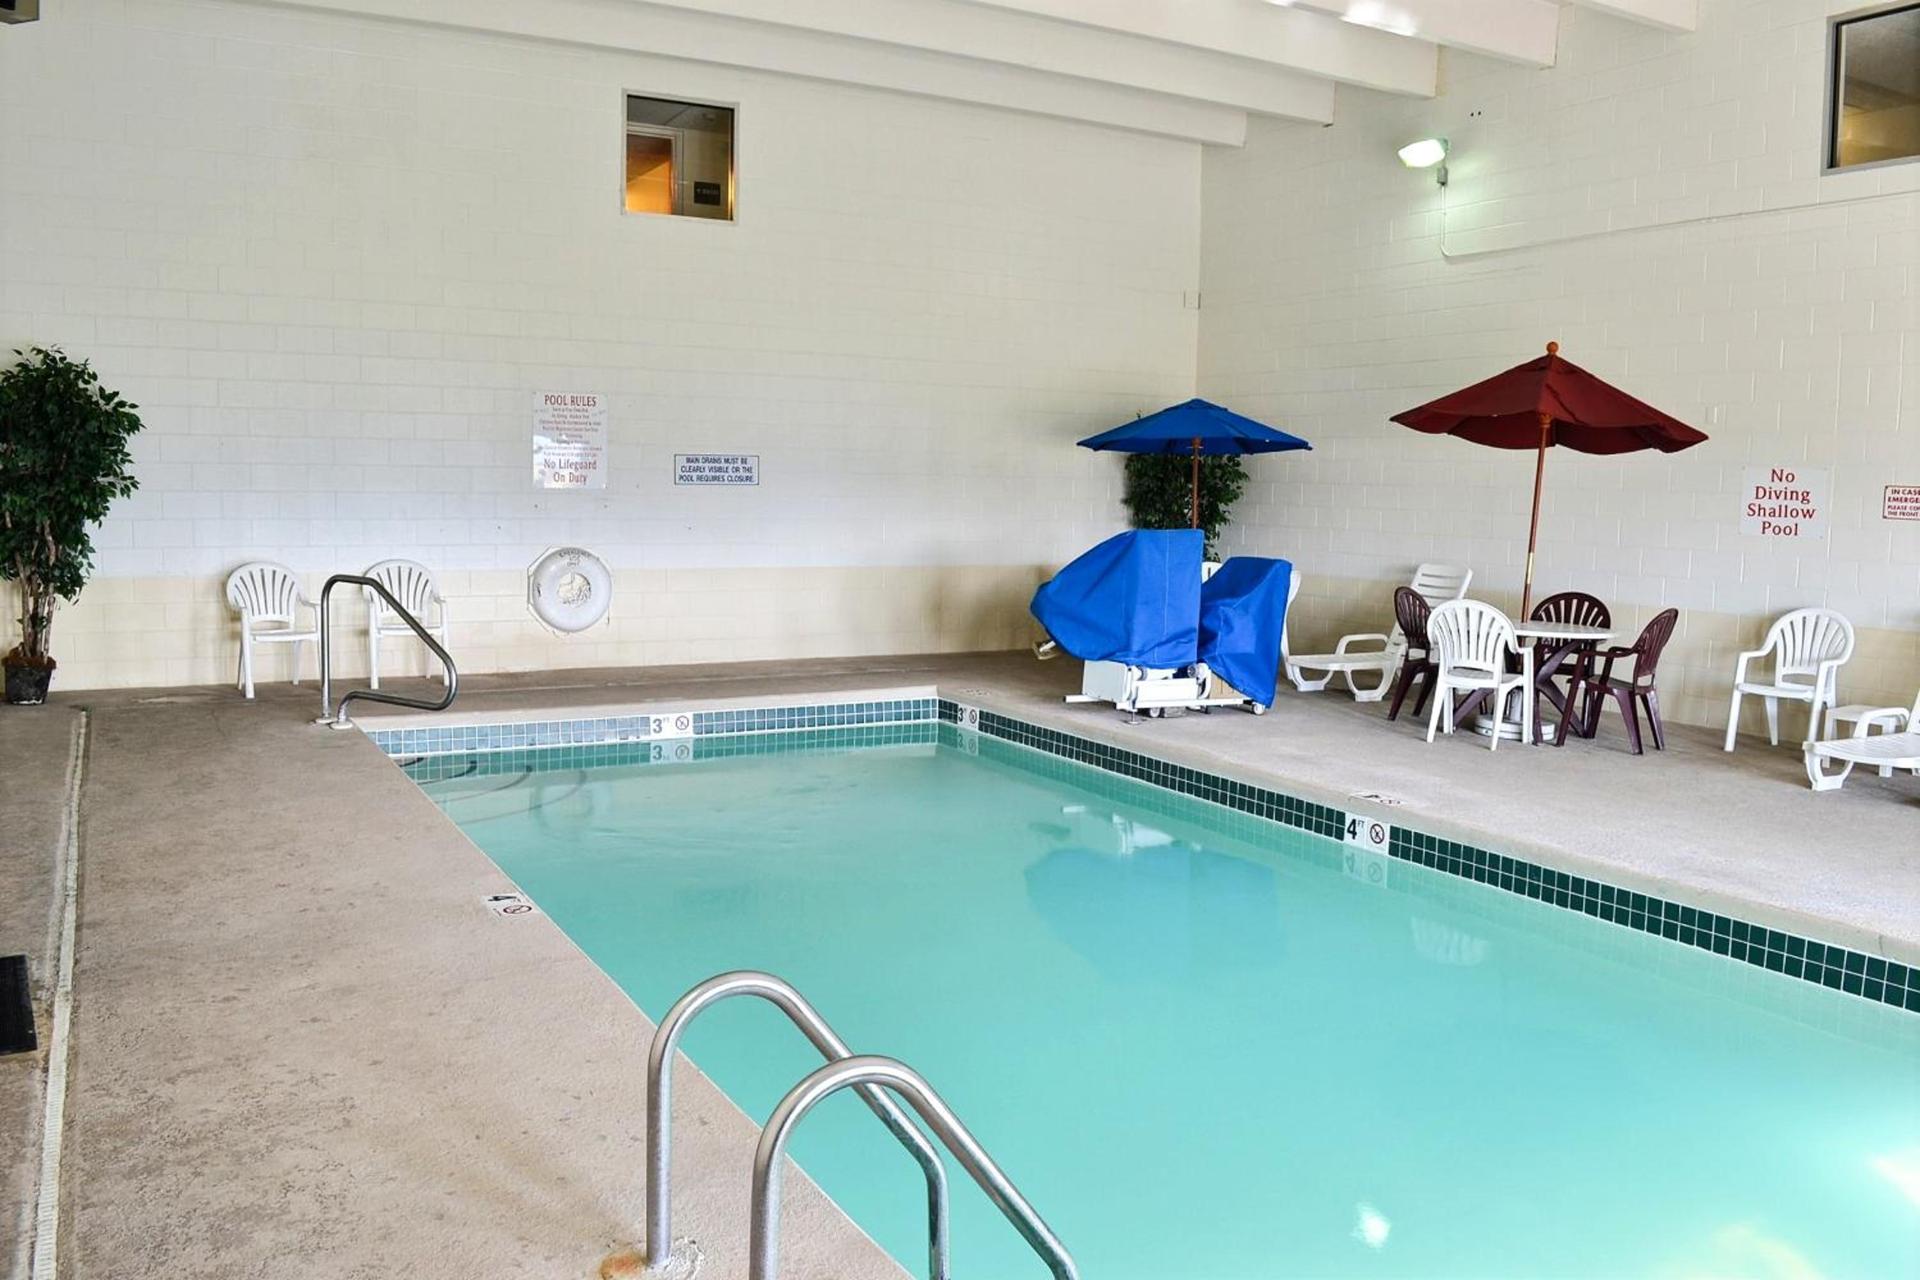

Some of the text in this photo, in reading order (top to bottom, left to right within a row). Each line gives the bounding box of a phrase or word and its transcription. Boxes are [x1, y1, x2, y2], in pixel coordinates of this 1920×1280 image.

[544, 394, 597, 407] POOL RULES
[544, 458, 597, 471] No Lifeguard
[723, 457, 739, 465] MUST
[680, 465, 706, 473] CLEARLY
[1771, 468, 1796, 483] No
[553, 472, 588, 485] On Duty
[679, 474, 694, 482] POOL
[696, 474, 725, 482] REQUIRES
[1755, 485, 1811, 505] Diving
[1747, 502, 1816, 519] Shallow
[1761, 520, 1798, 536] Pool
